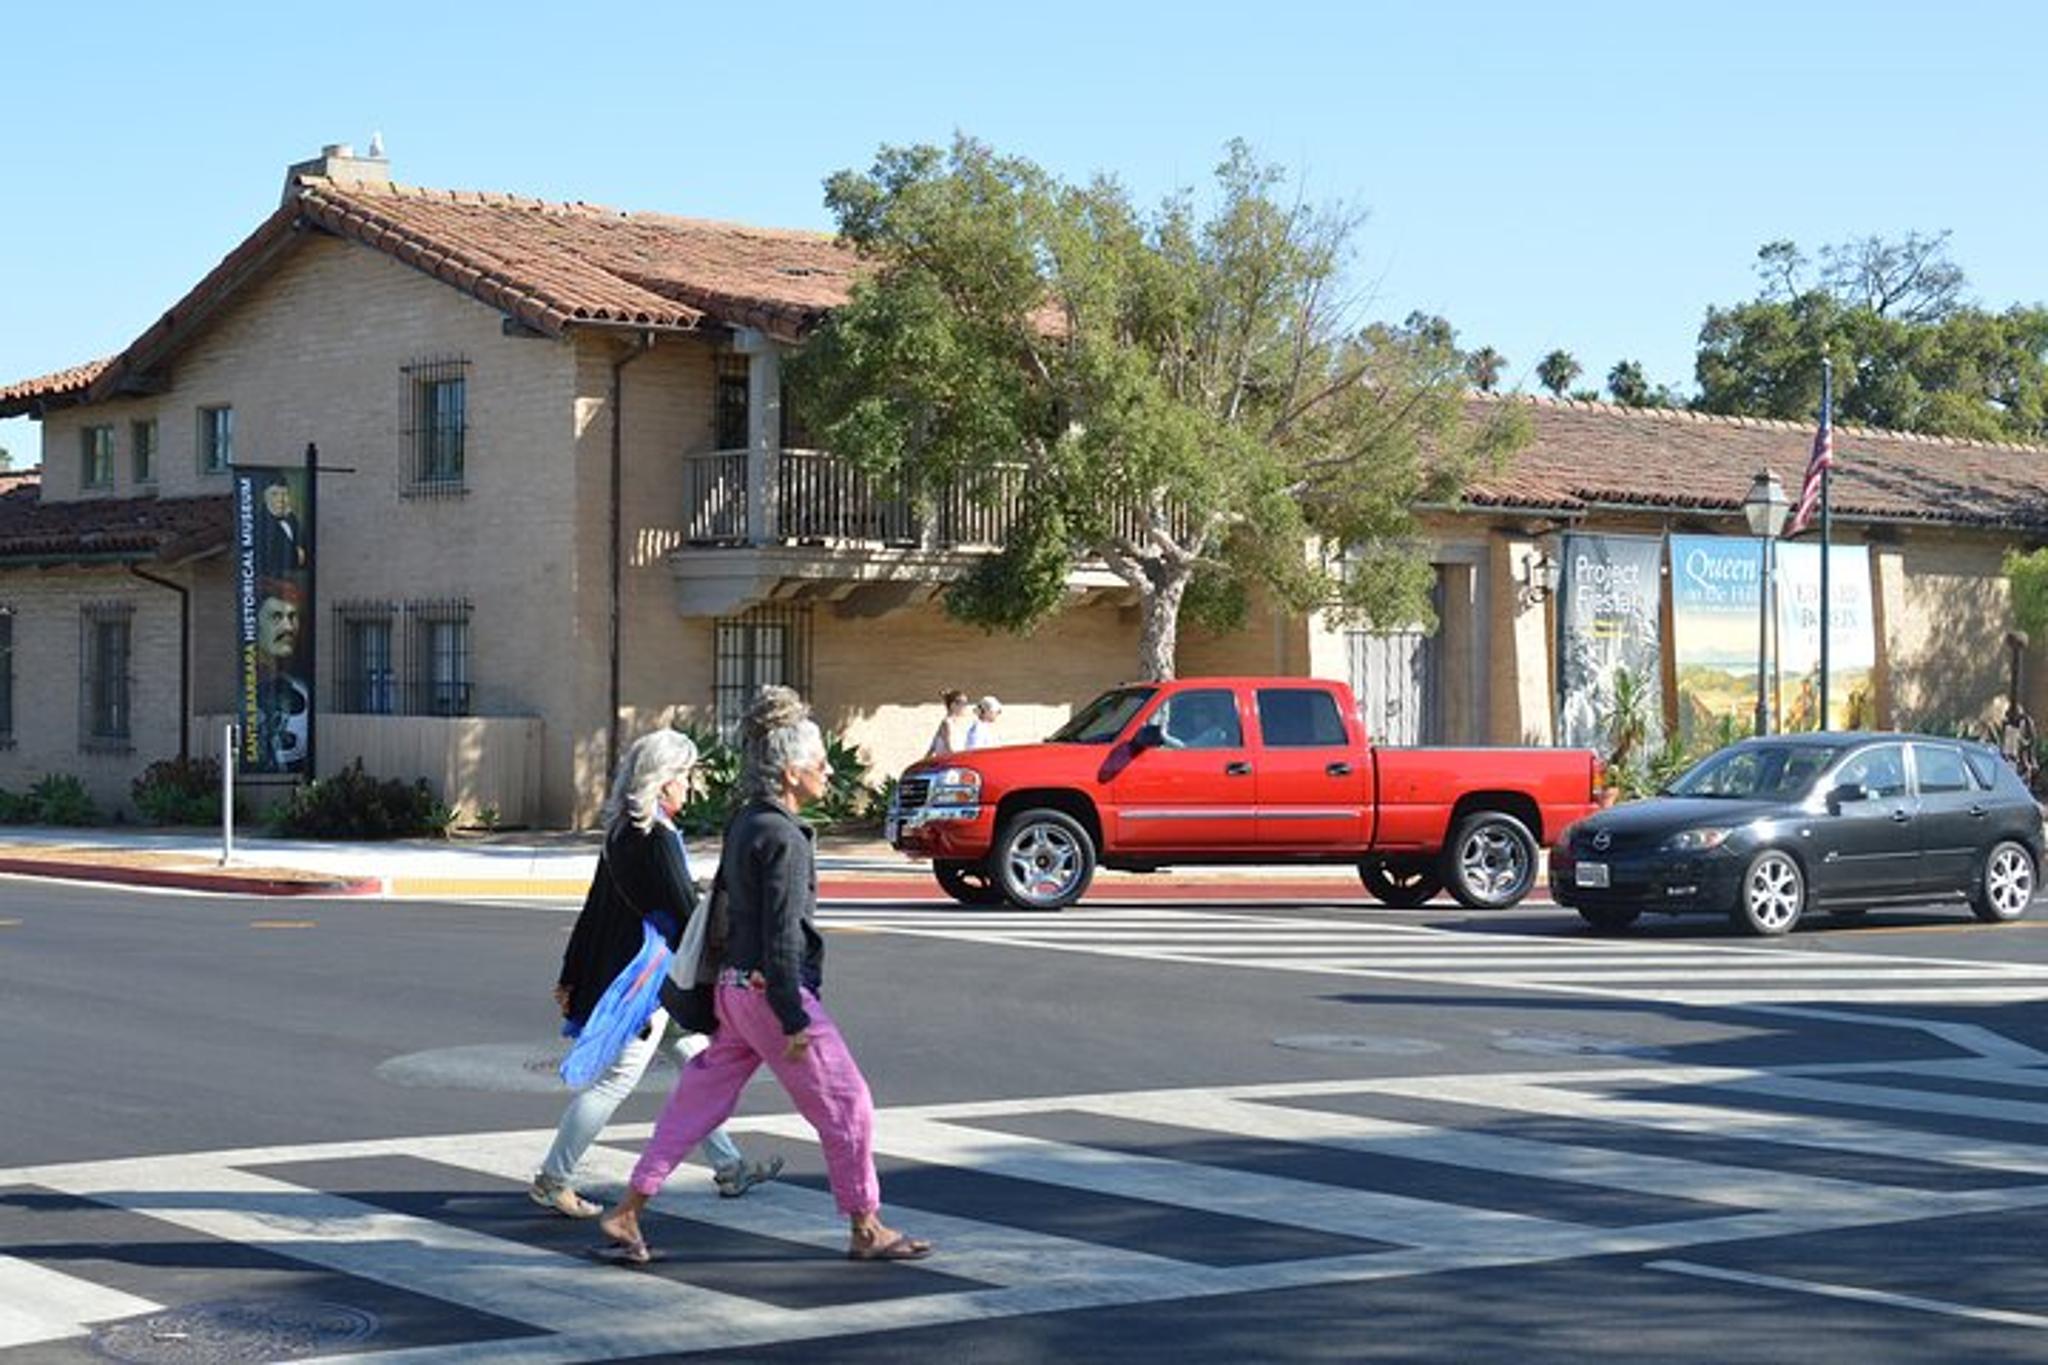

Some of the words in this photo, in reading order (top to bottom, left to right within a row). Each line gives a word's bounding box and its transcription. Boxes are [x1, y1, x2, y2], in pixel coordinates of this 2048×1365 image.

[240, 477, 253, 547] MUSEUM
[243, 550, 256, 641] HISTORICAL
[1576, 554, 1639, 592] Project
[1686, 549, 1756, 590] Queen
[244, 643, 257, 712] BARBARA
[245, 713, 257, 762] SANTA
